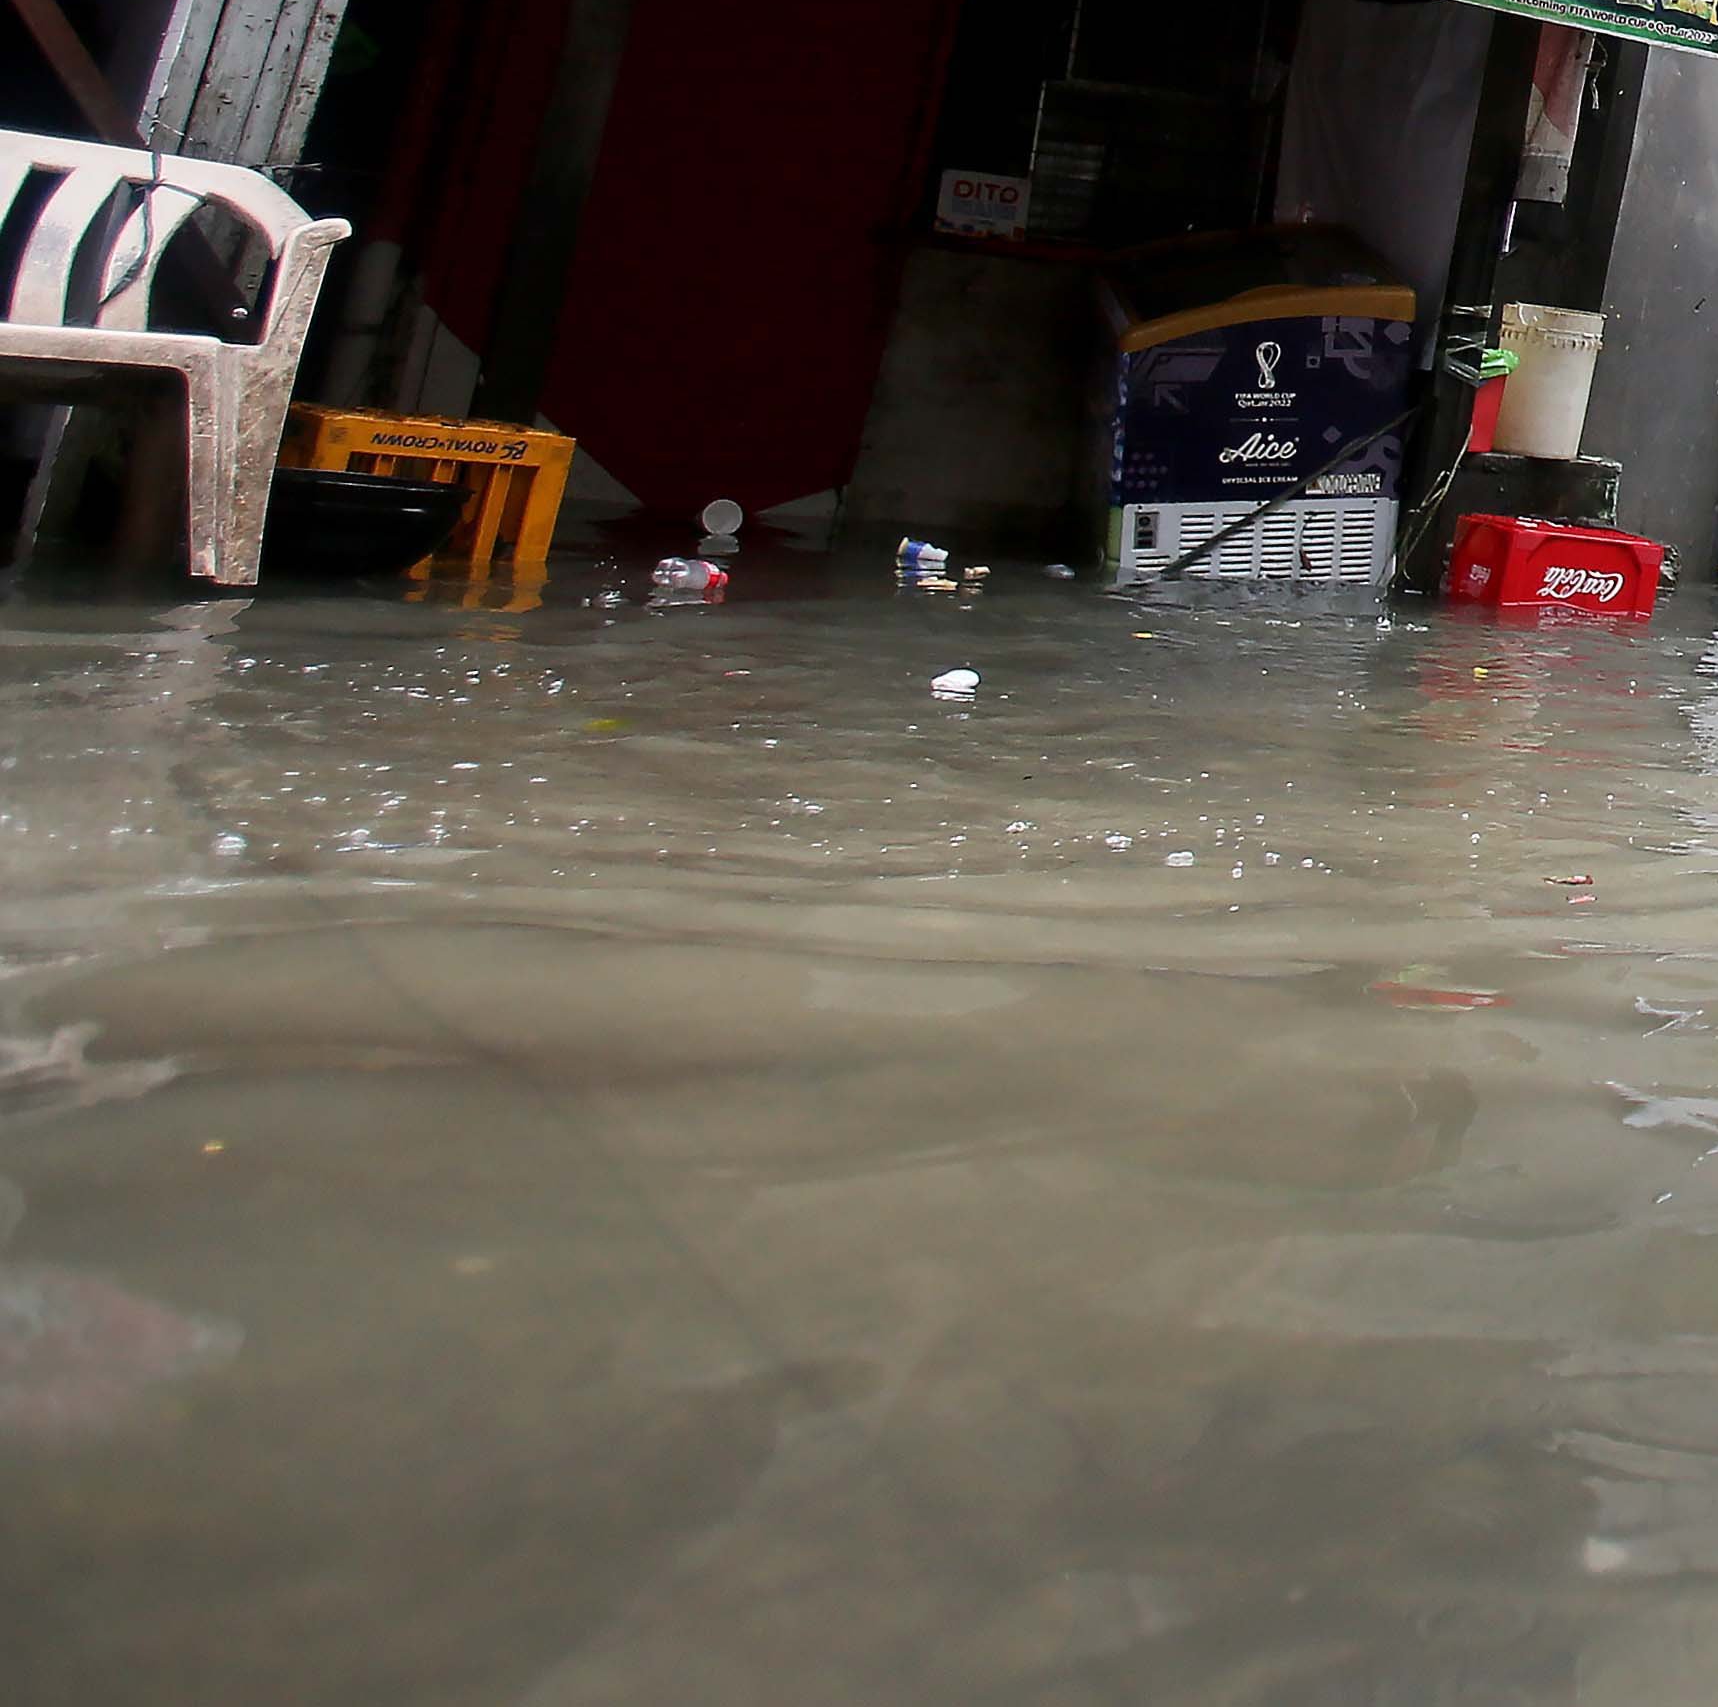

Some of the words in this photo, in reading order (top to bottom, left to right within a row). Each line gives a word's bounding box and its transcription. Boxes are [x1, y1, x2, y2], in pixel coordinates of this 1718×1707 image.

[1569, 5, 1592, 19] FIFA
[1592, 10, 1627, 26] WORLD
[1627, 15, 1648, 29] CUP
[1219, 433, 1297, 463] Aice
